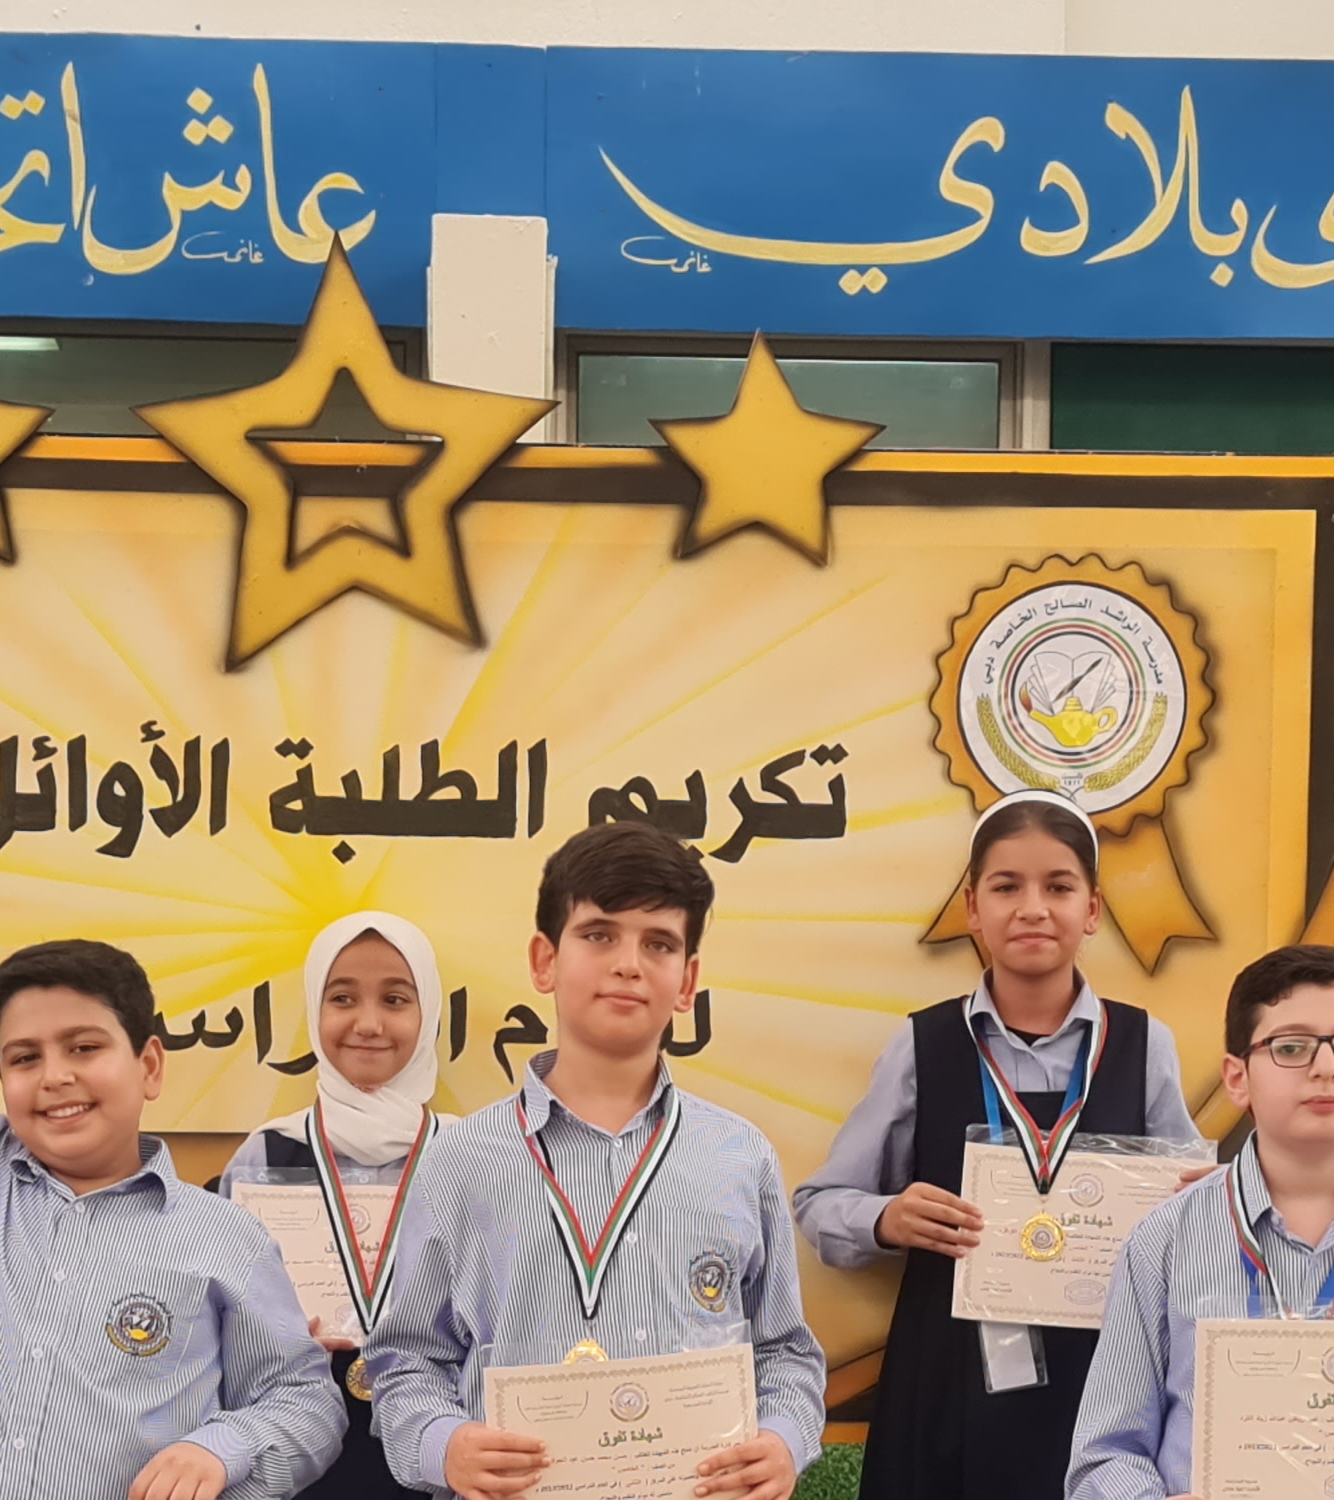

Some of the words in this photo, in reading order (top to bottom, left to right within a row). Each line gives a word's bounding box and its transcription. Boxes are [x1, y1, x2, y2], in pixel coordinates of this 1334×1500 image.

[83, 60, 377, 277] عاش
[598, 84, 1249, 295] بلادي
[989, 606, 1038, 650] الخاصة
[1044, 597, 1092, 616] الصالح
[1100, 605, 1142, 636] الراشد
[983, 656, 995, 685] دبي
[1141, 636, 1164, 685] مدرسة
[269, 736, 547, 864] الطلبة
[632, 1427, 663, 1443] شهادة
